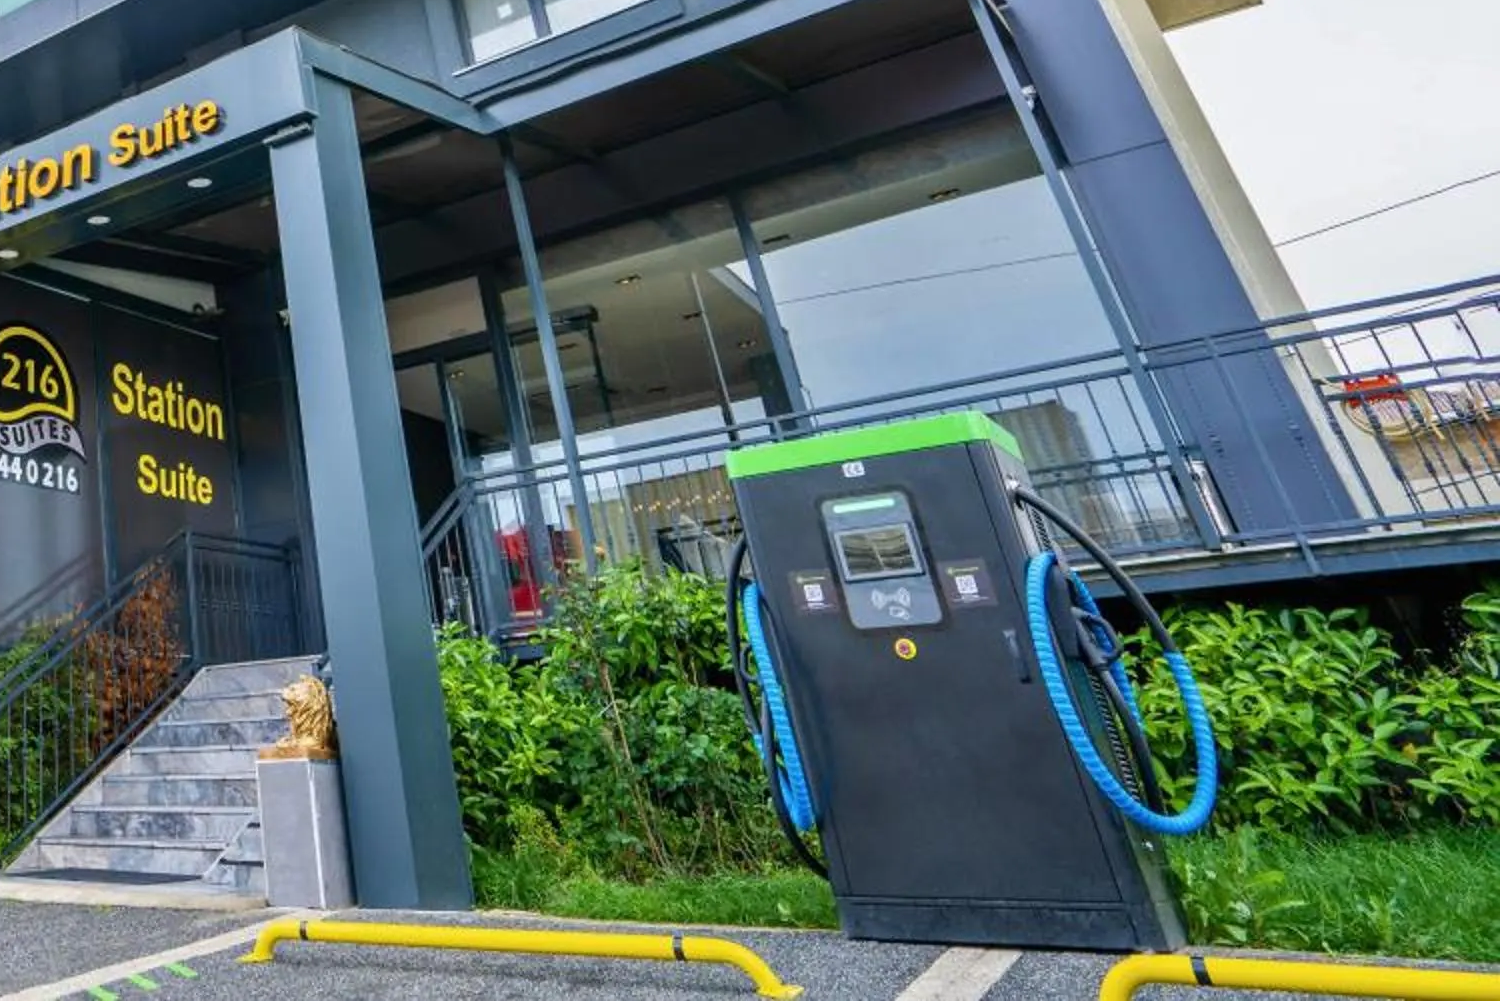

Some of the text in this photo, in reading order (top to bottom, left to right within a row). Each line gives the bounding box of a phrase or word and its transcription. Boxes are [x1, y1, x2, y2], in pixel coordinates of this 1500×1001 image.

[107, 99, 222, 167] Suite
[0, 352, 60, 400] 216
[110, 361, 226, 441] Station
[0, 418, 72, 447] SUITES
[136, 453, 214, 505] Suite
